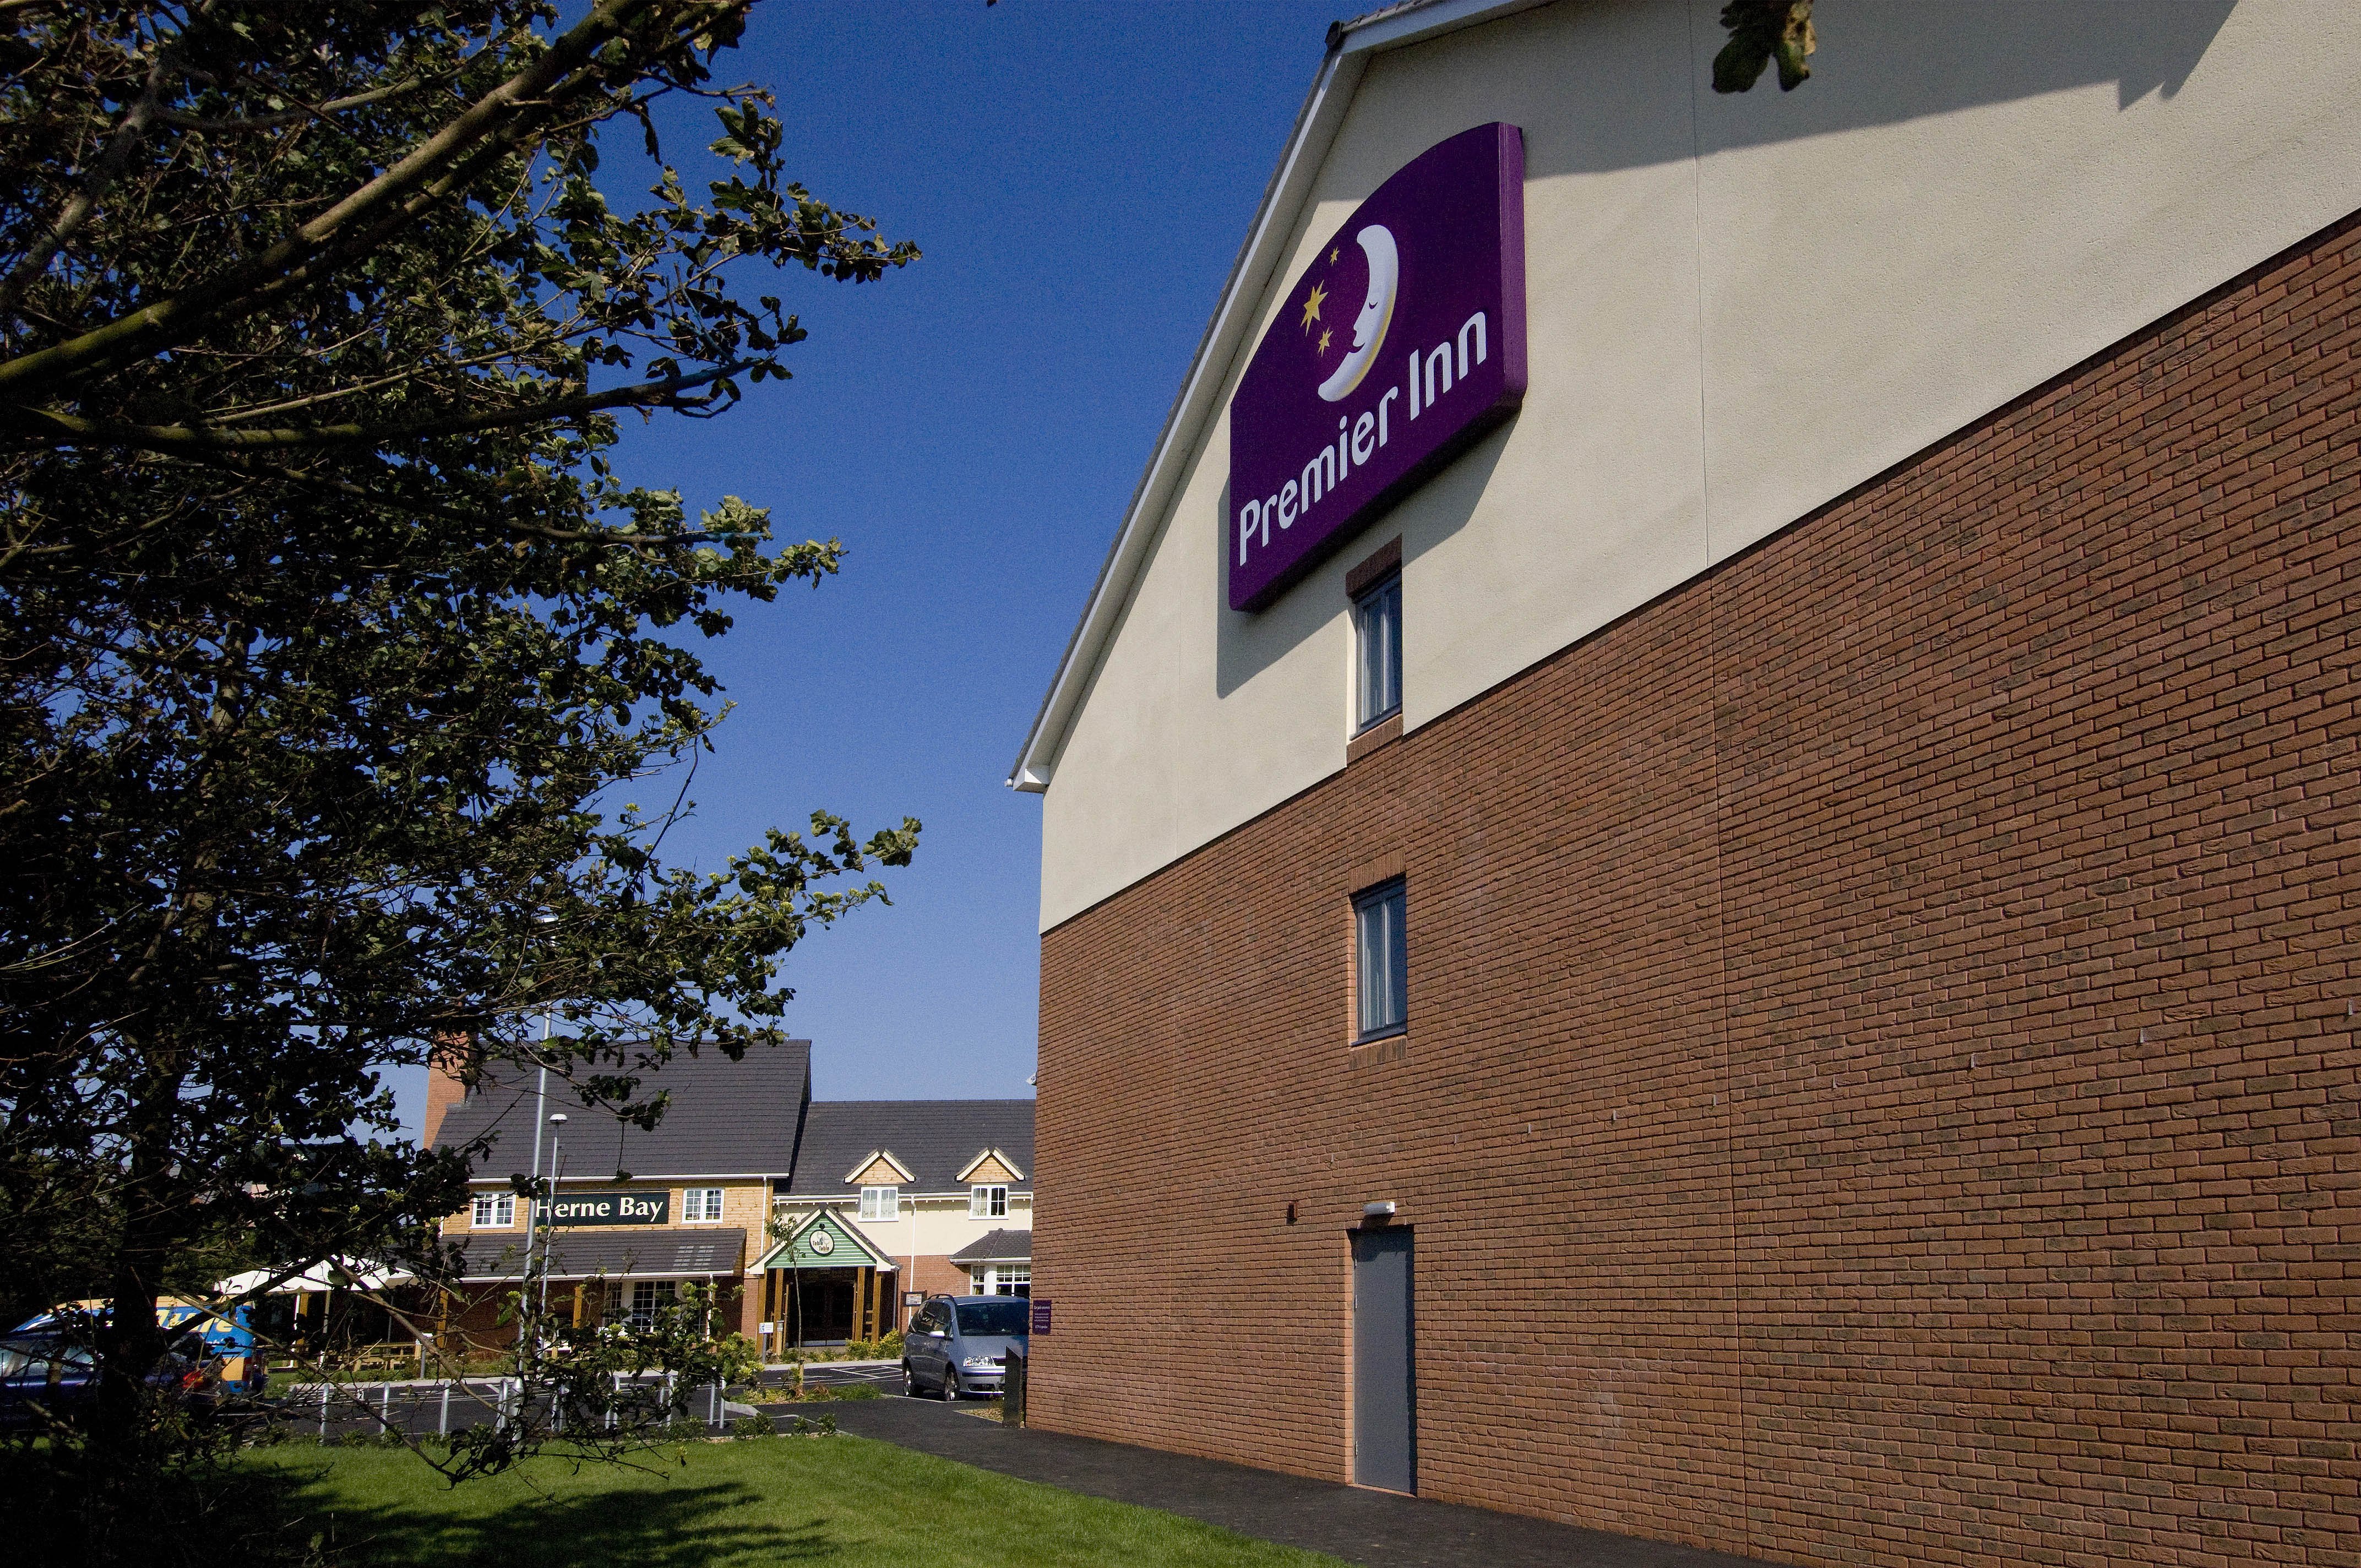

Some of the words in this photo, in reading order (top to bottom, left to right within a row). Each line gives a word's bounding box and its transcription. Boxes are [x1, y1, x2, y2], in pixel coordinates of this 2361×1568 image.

[1240, 386, 1399, 567] Premier
[1410, 311, 1487, 421] Inn
[536, 1199, 611, 1218] Herne
[619, 1197, 663, 1222] Bay
